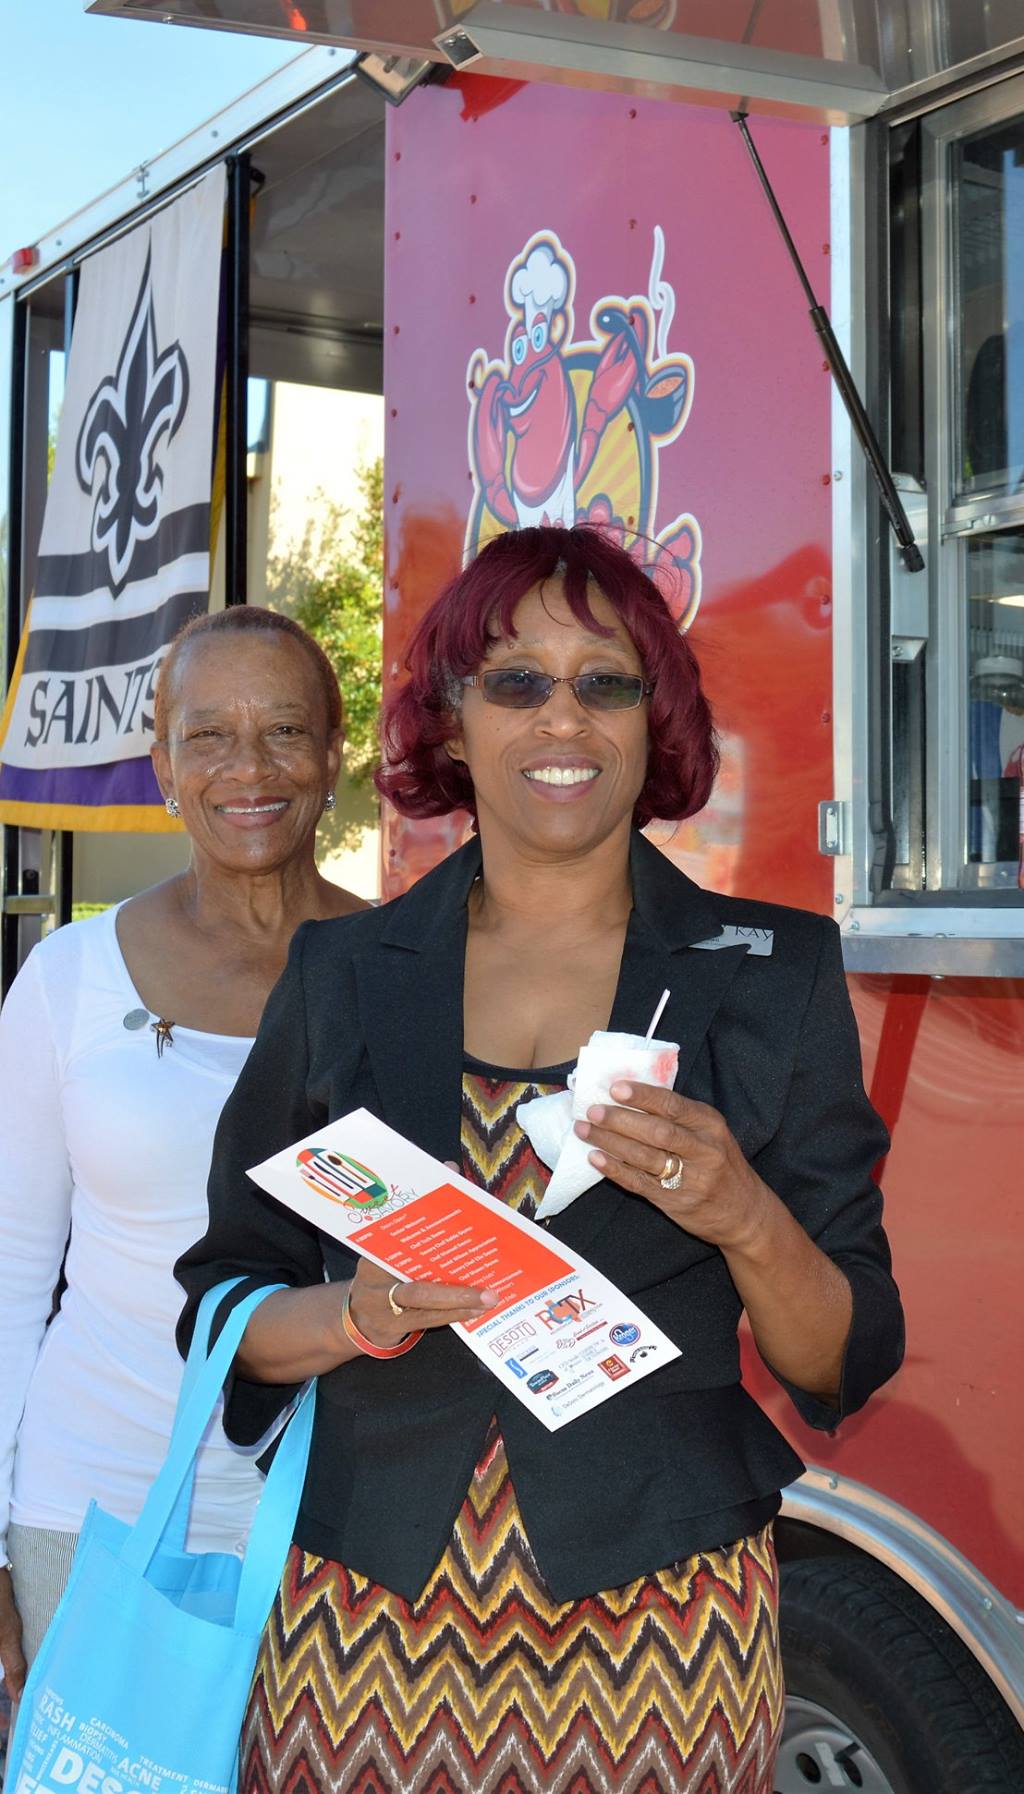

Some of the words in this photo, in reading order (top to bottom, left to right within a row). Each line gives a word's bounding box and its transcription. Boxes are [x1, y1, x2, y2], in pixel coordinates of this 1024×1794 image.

[735, 925, 774, 942] KAY
[477, 1319, 502, 1337] SPECIAL
[501, 1304, 526, 1322] THANKS
[534, 1290, 548, 1304] OUR
[489, 1322, 537, 1358] DESOTO
[38, 1695, 76, 1732] RASH
[117, 1757, 161, 1791] ACNE
[139, 1755, 189, 1783] TREATMENT
